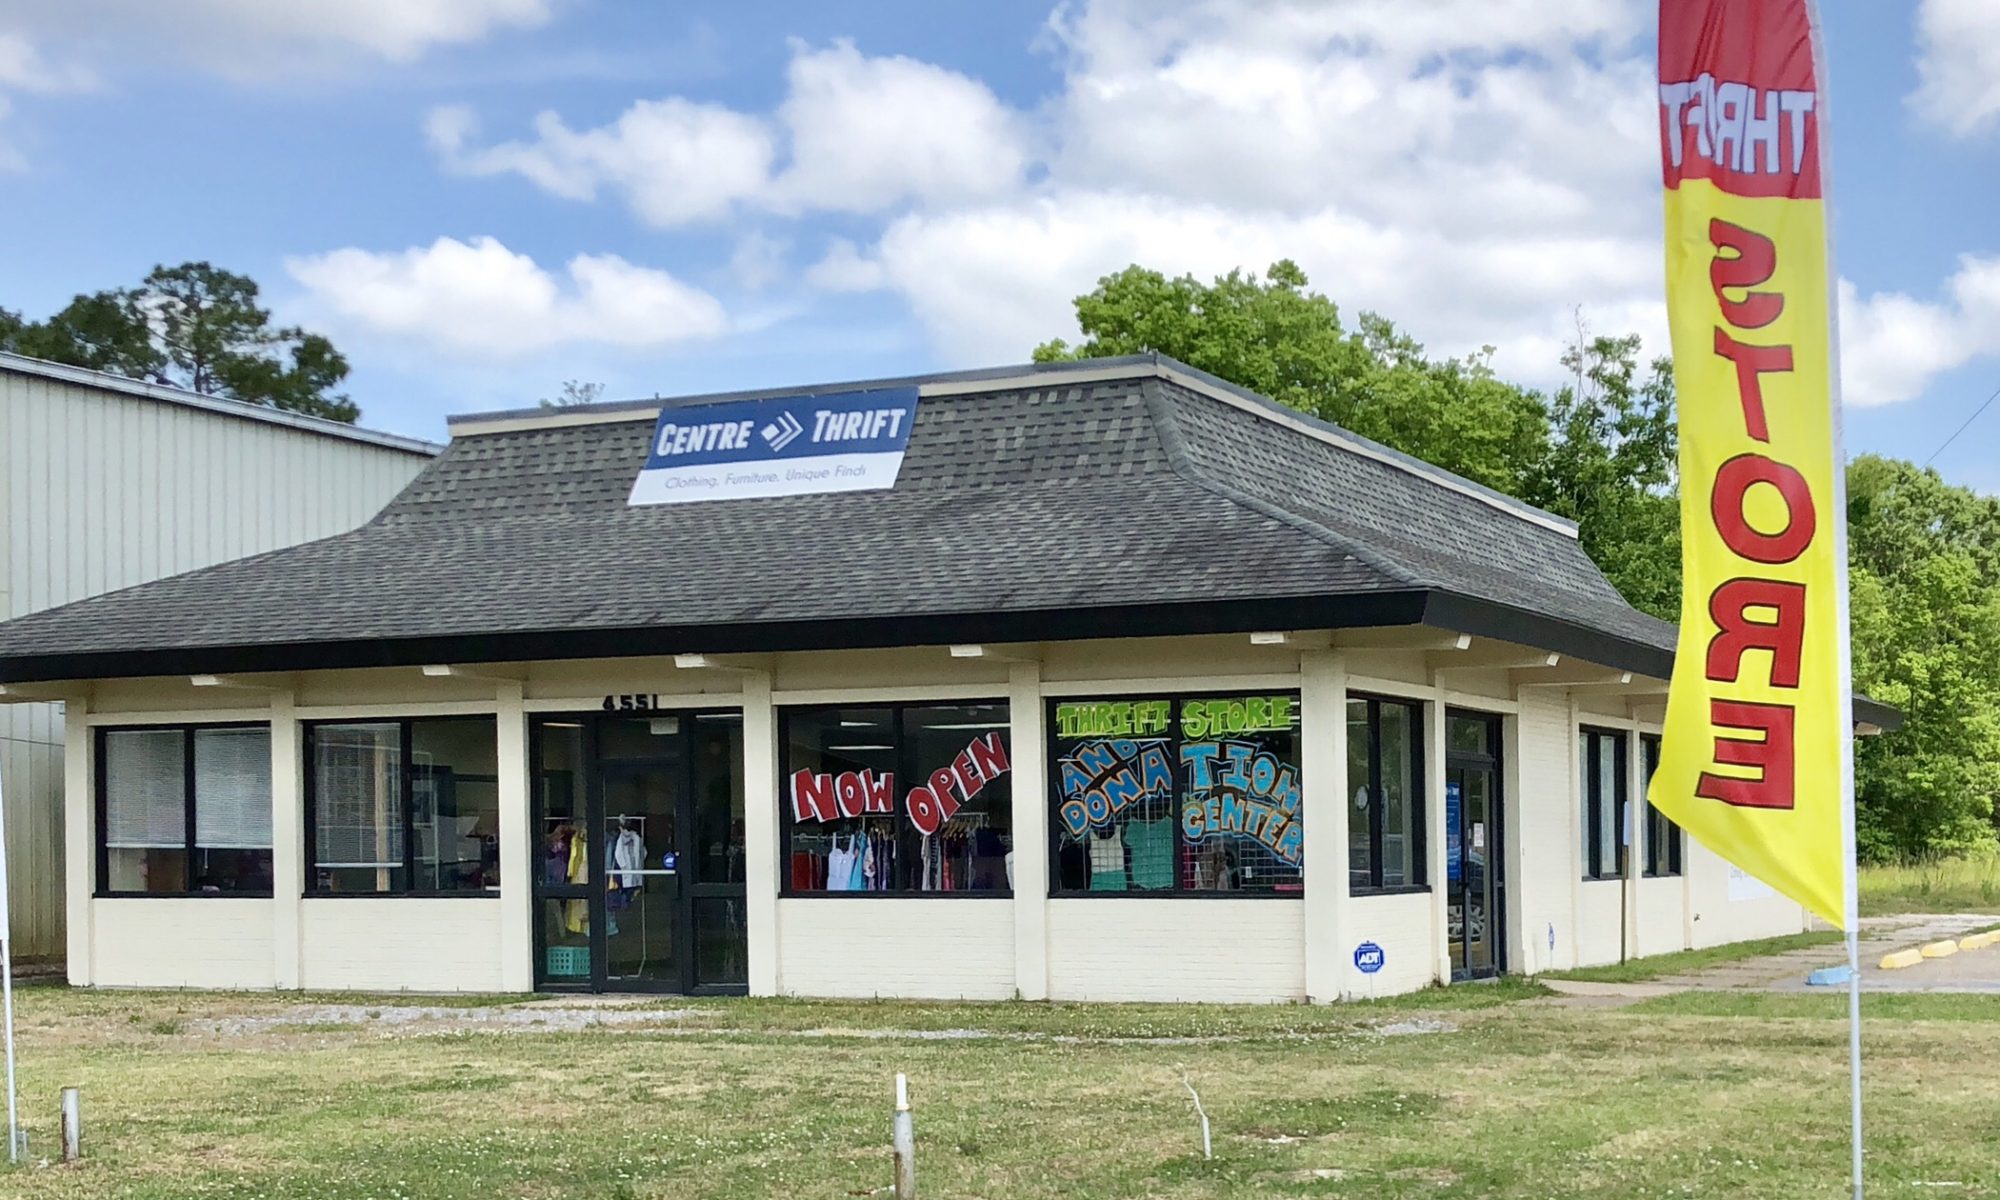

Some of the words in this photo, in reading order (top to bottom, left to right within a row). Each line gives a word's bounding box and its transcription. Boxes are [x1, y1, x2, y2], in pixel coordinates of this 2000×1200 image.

[656, 420, 754, 457] CENTRE
[811, 408, 907, 443] THRIFT
[785, 467, 830, 482] Unique
[602, 694, 658, 710] 4551
[1056, 702, 1171, 737] THRIFT
[1182, 696, 1293, 738] STORE
[790, 767, 895, 824] NOW
[905, 731, 1012, 836] OPEN
[1060, 739, 1139, 797] AND
[1182, 793, 1303, 862] CENTER
[1359, 951, 1379, 964] ADT
